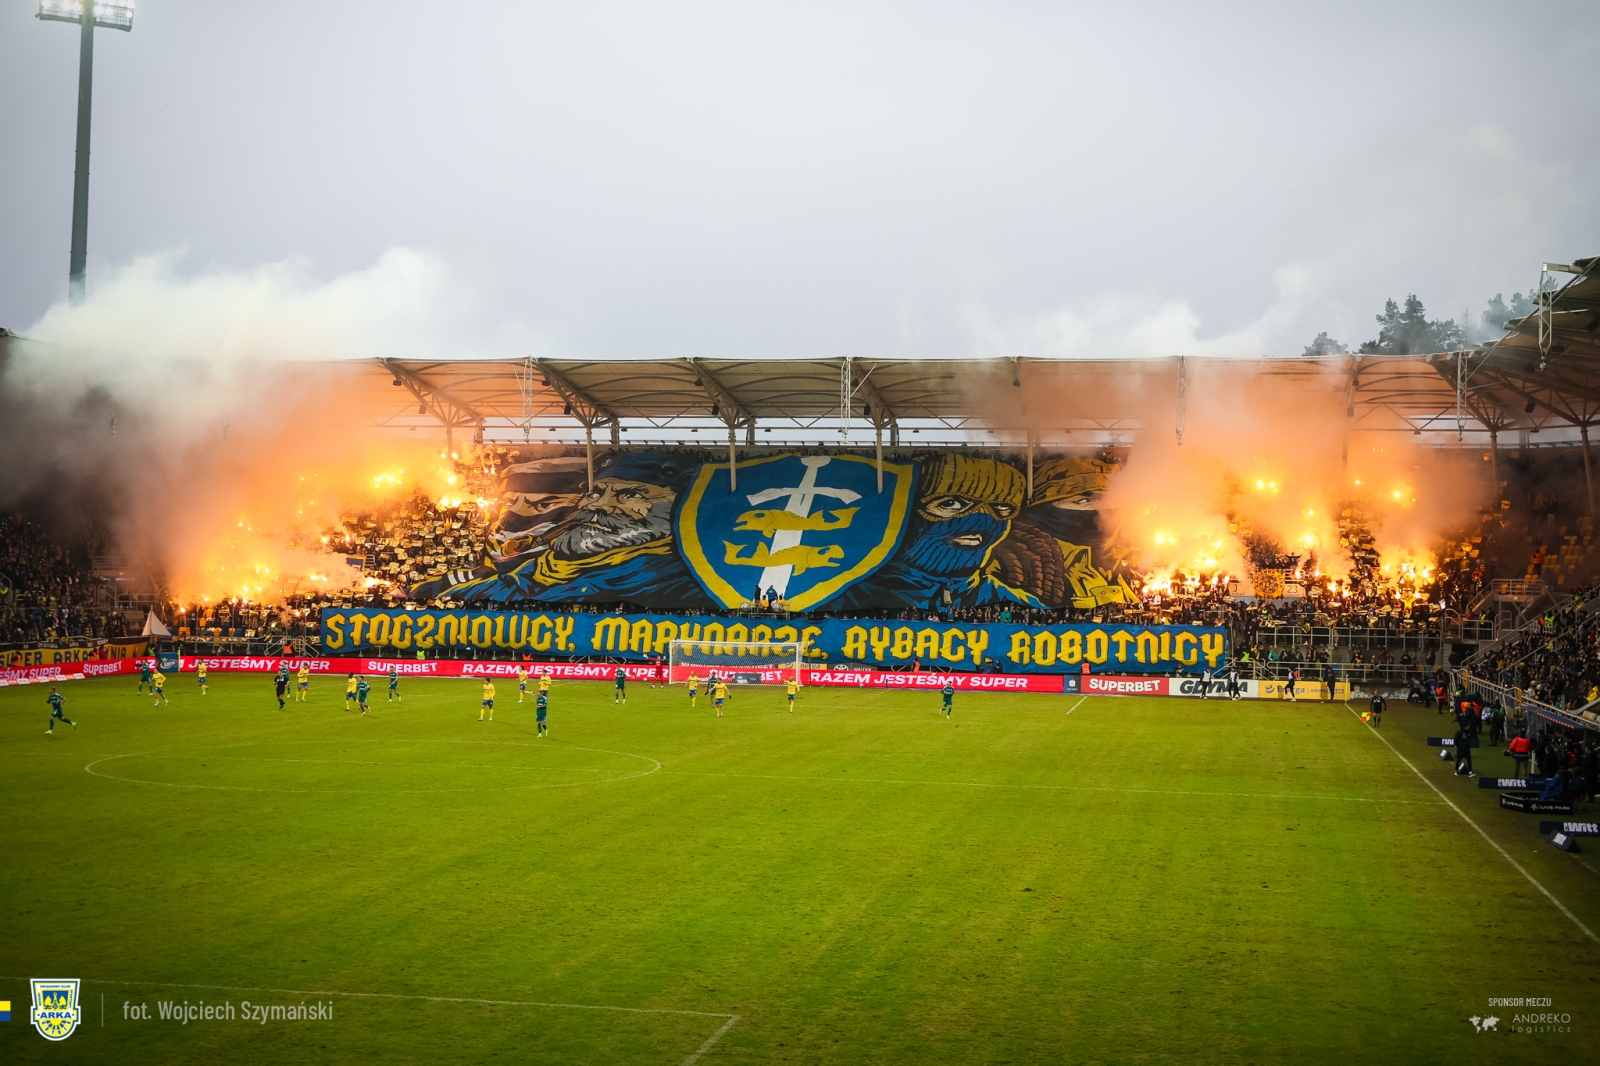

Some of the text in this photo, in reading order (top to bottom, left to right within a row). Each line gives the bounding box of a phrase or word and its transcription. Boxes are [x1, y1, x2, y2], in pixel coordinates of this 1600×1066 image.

[1286, 585, 1299, 594] 23
[1007, 628, 1224, 669] ROBOTNICY
[29, 666, 61, 679] SUPER
[83, 661, 122, 674] SUPERBET
[367, 661, 438, 673] SUPERBET
[462, 663, 520, 675] RAZEM
[526, 664, 612, 676] JESTEŚMY
[810, 672, 1028, 688] RAZEM JESTEŚMY SUPER
[1089, 678, 1160, 692] SUPERBET
